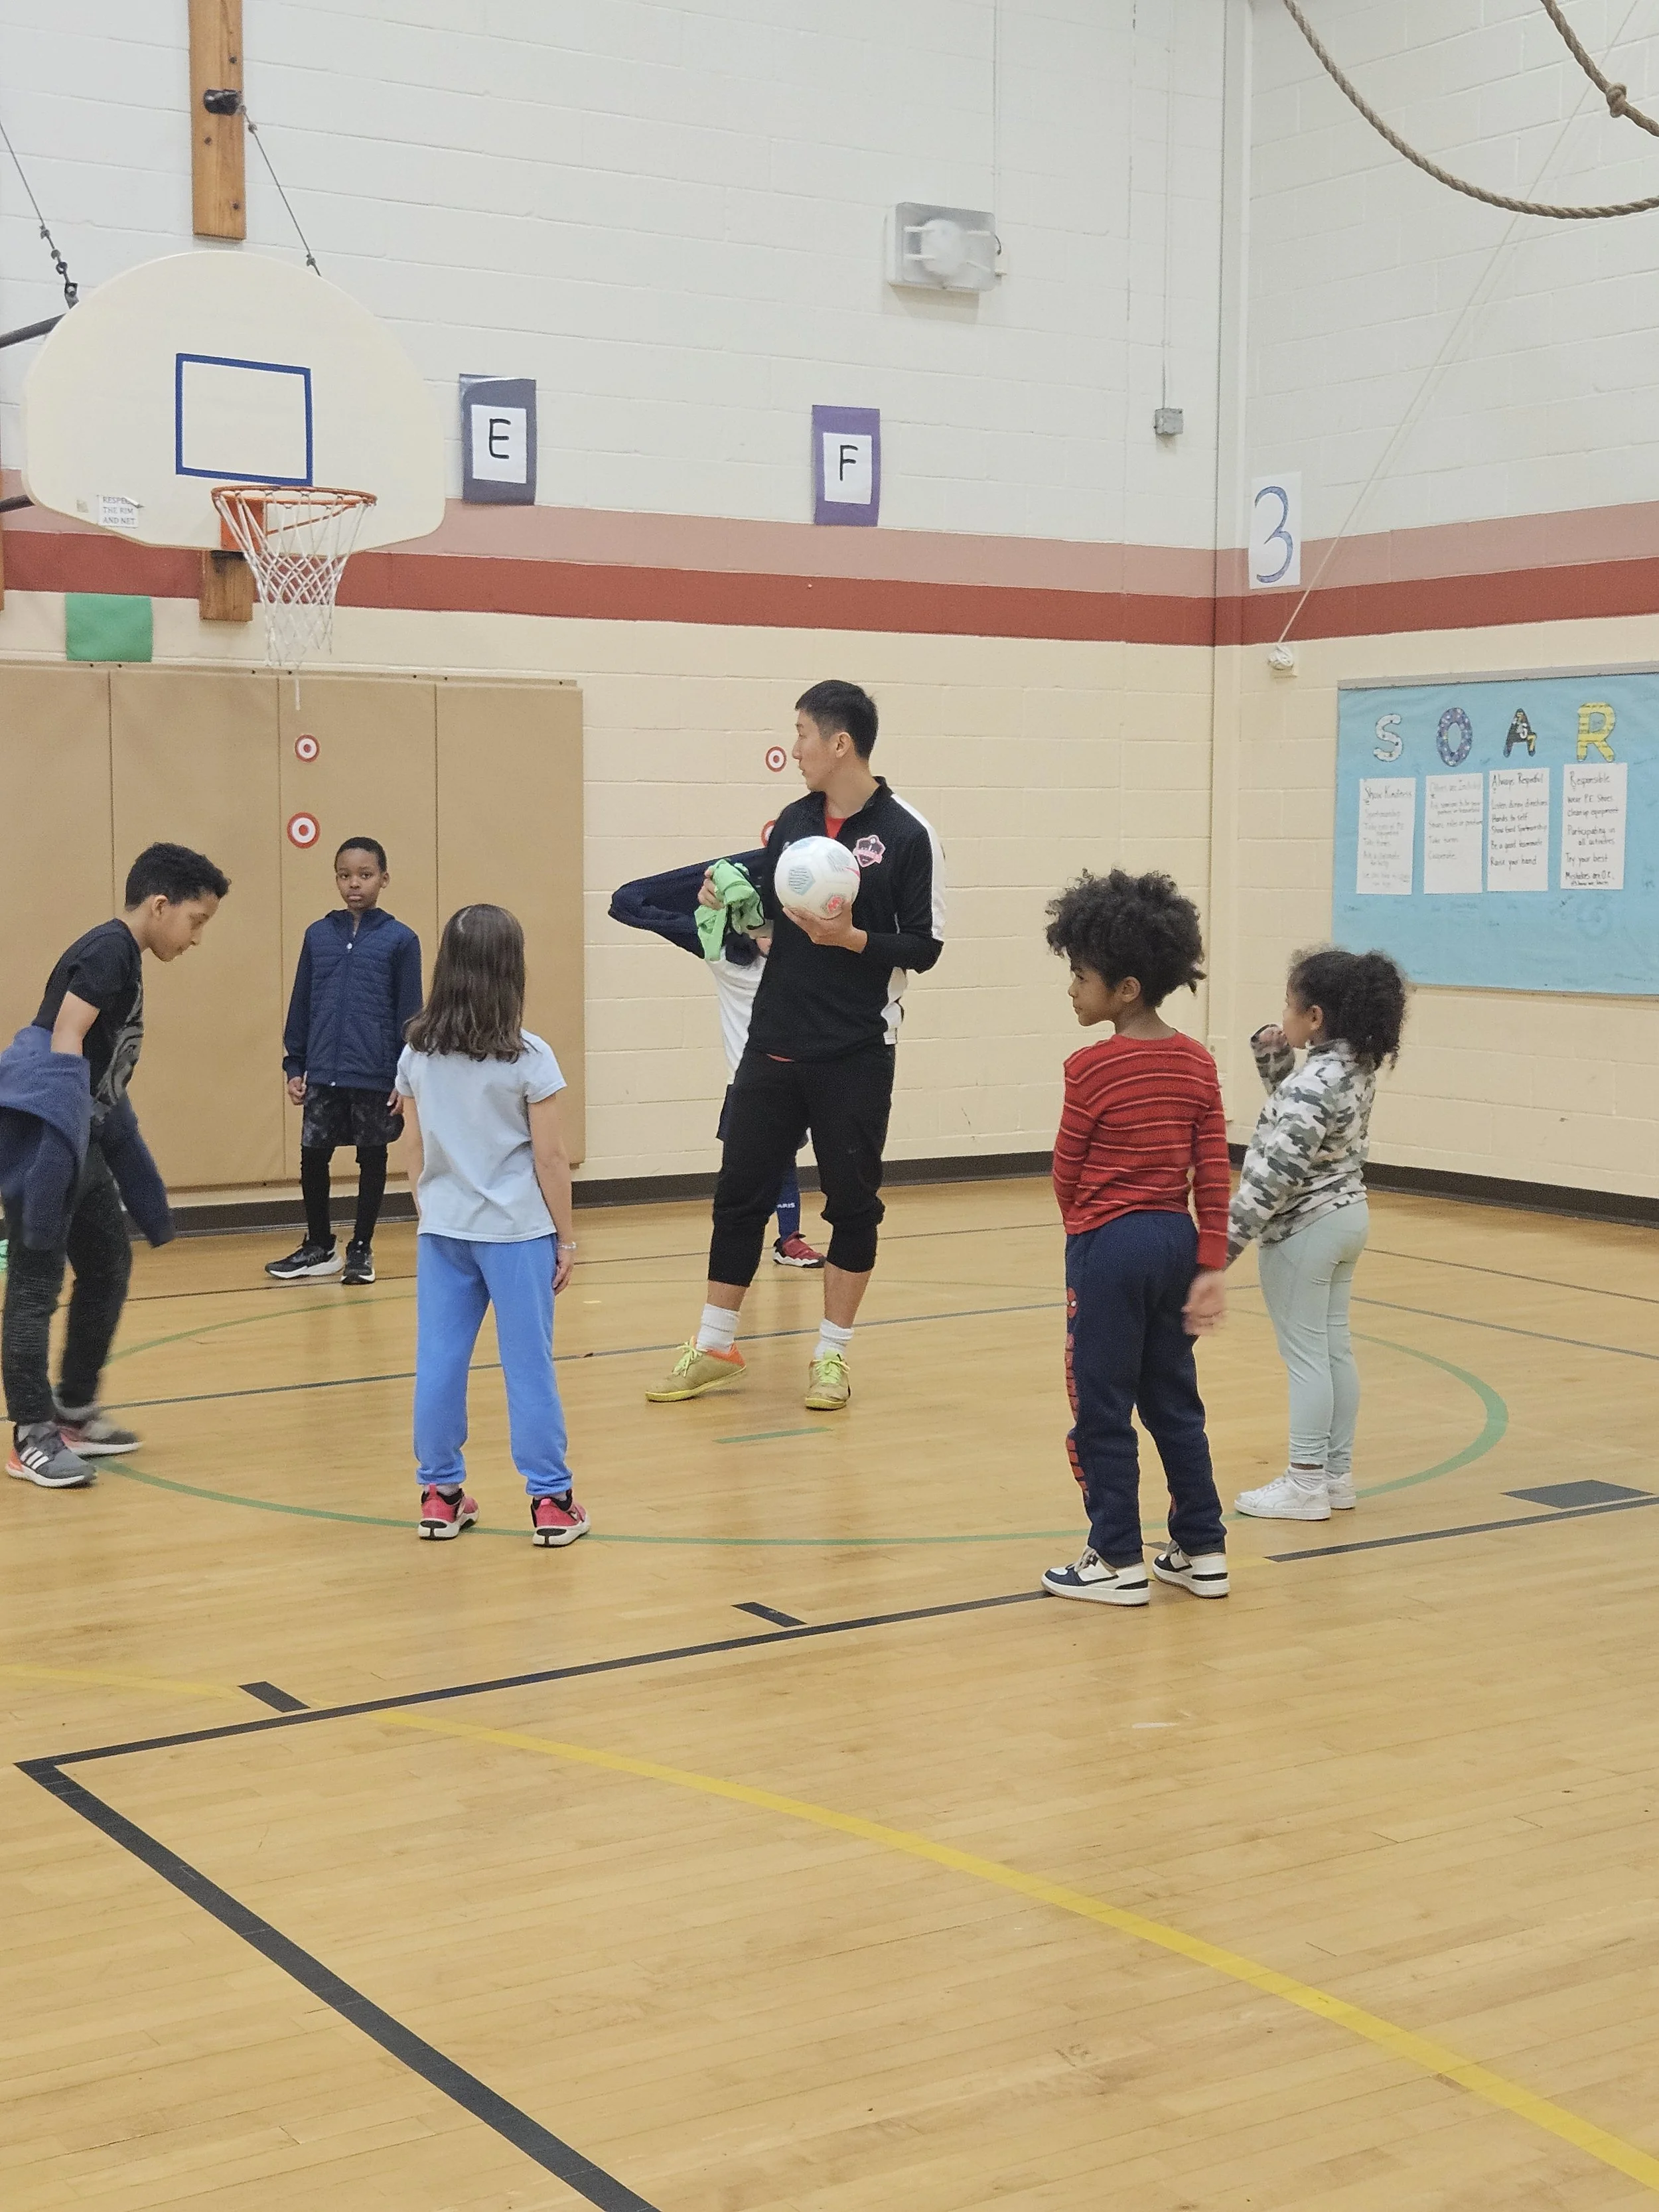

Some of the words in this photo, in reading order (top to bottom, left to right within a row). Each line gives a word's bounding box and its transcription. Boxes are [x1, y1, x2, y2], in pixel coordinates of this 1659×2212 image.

[489, 418, 511, 459] E
[839, 445, 858, 481] F
[1254, 486, 1293, 583] 3
